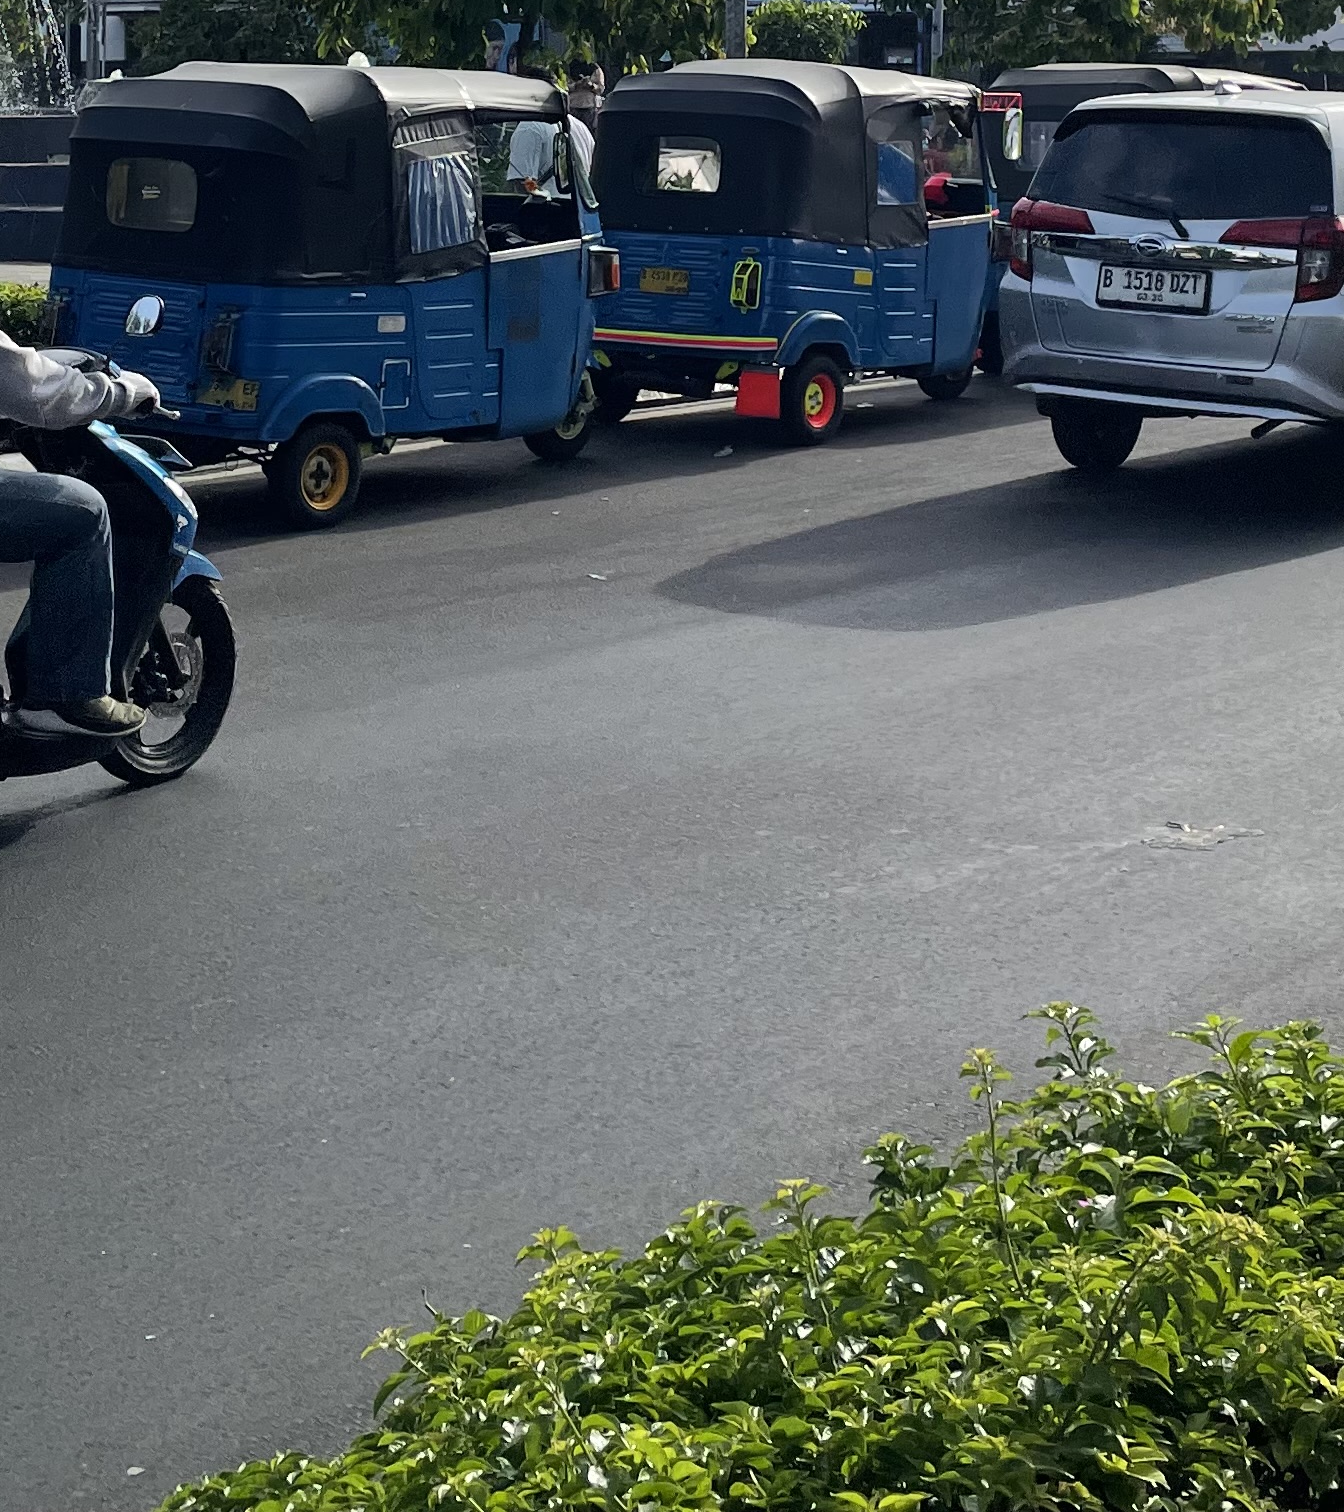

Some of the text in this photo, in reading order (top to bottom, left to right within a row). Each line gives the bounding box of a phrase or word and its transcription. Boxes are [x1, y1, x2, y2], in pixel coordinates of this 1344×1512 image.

[1103, 268, 1203, 295] B 1518 DZT
